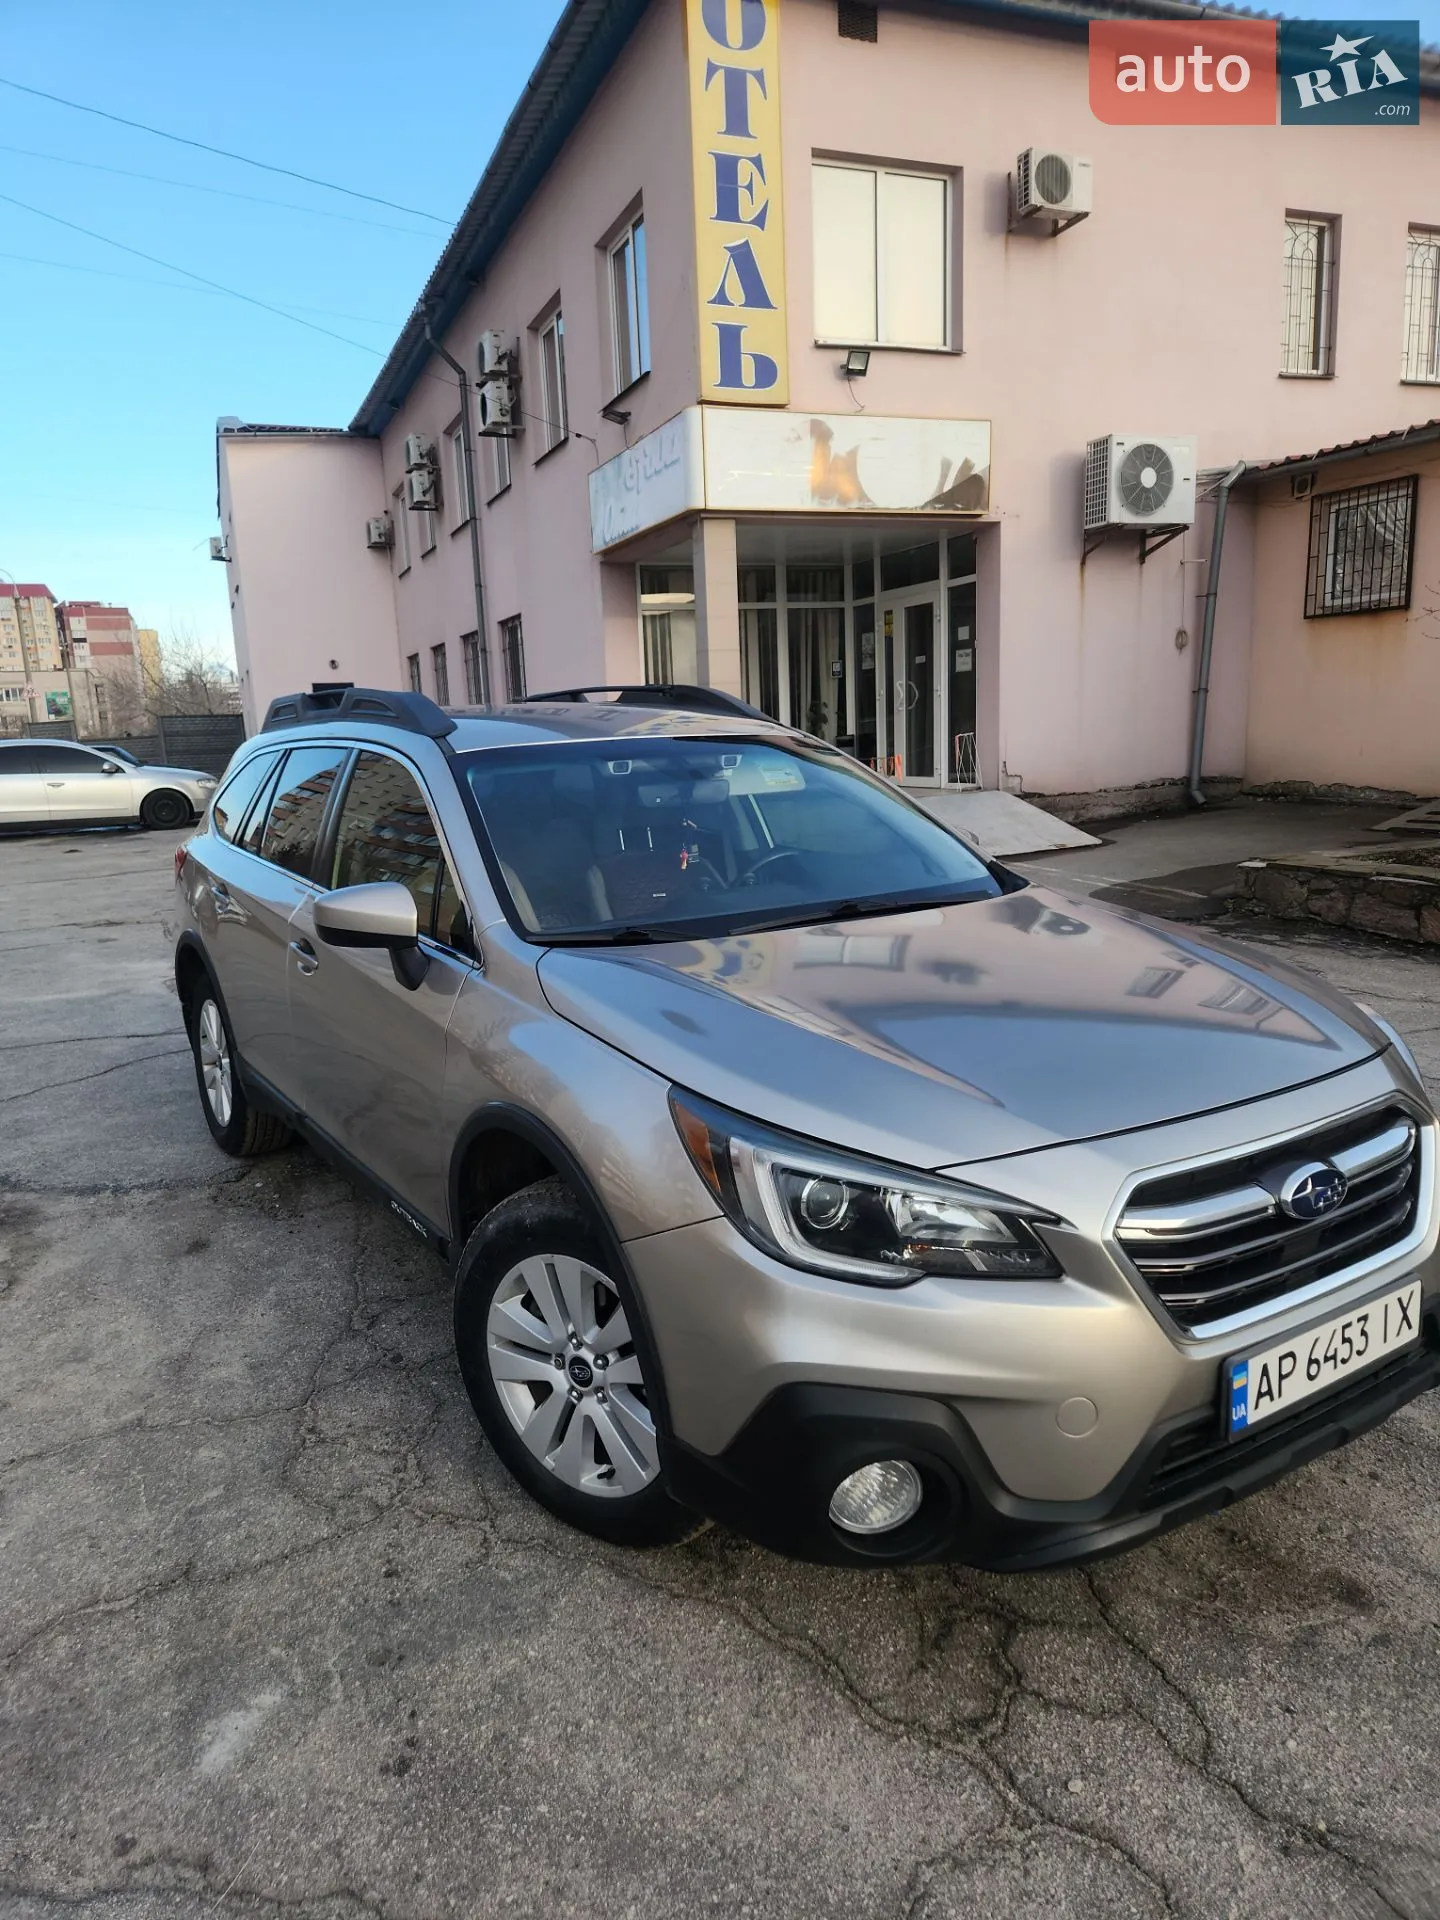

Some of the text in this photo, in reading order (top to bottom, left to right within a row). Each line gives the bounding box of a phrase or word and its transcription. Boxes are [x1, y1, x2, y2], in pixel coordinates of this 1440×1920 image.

[1254, 1351, 1297, 1411] AP
[1306, 1314, 1369, 1383] 6453
[1232, 1403, 1247, 1421] UA
